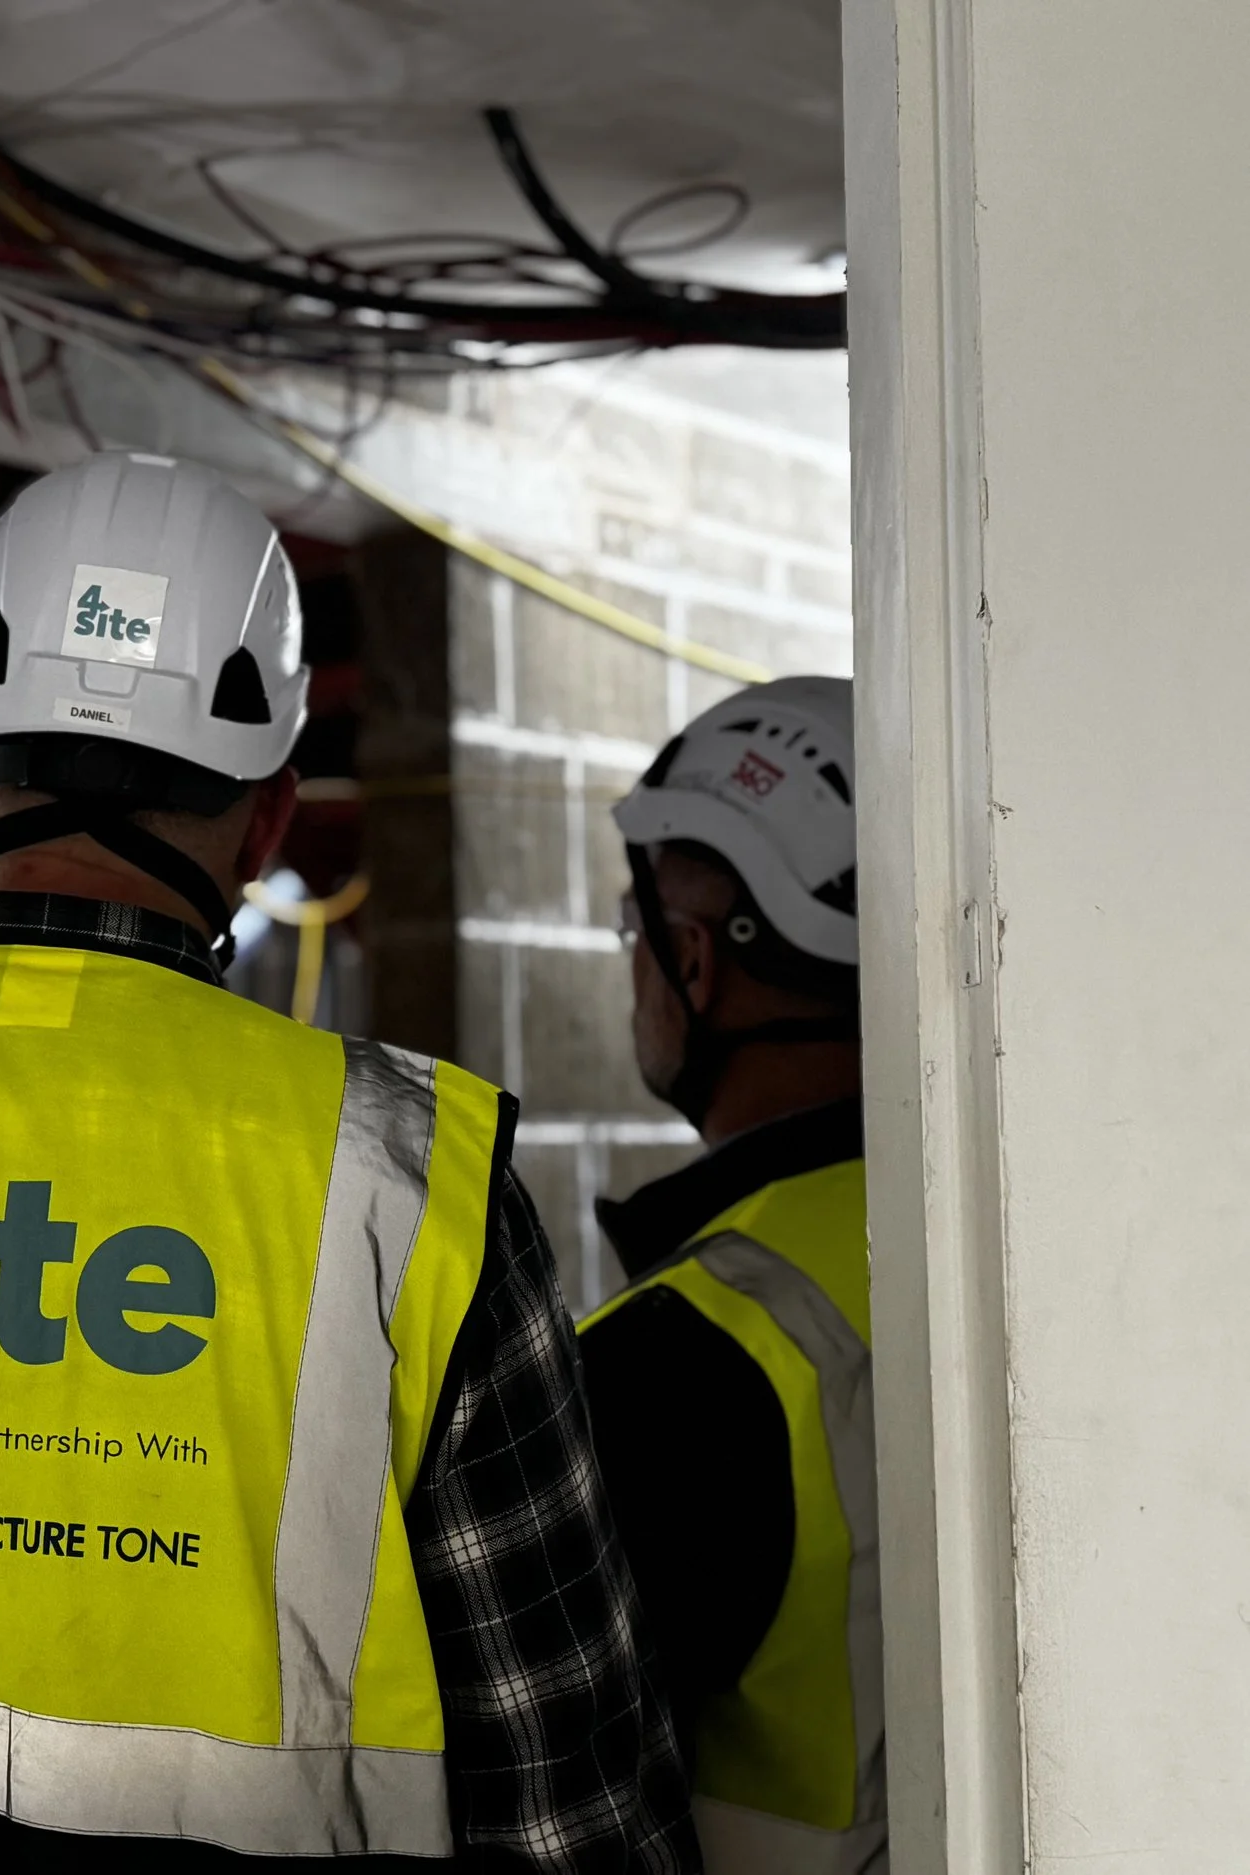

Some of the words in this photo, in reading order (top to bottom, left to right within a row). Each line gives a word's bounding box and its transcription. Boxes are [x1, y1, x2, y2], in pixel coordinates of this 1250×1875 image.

[77, 584, 110, 614] 4
[73, 608, 151, 644] site
[70, 707, 113, 723] DANIEL
[137, 1433, 208, 1465] With
[97, 1525, 201, 1567] TONE
